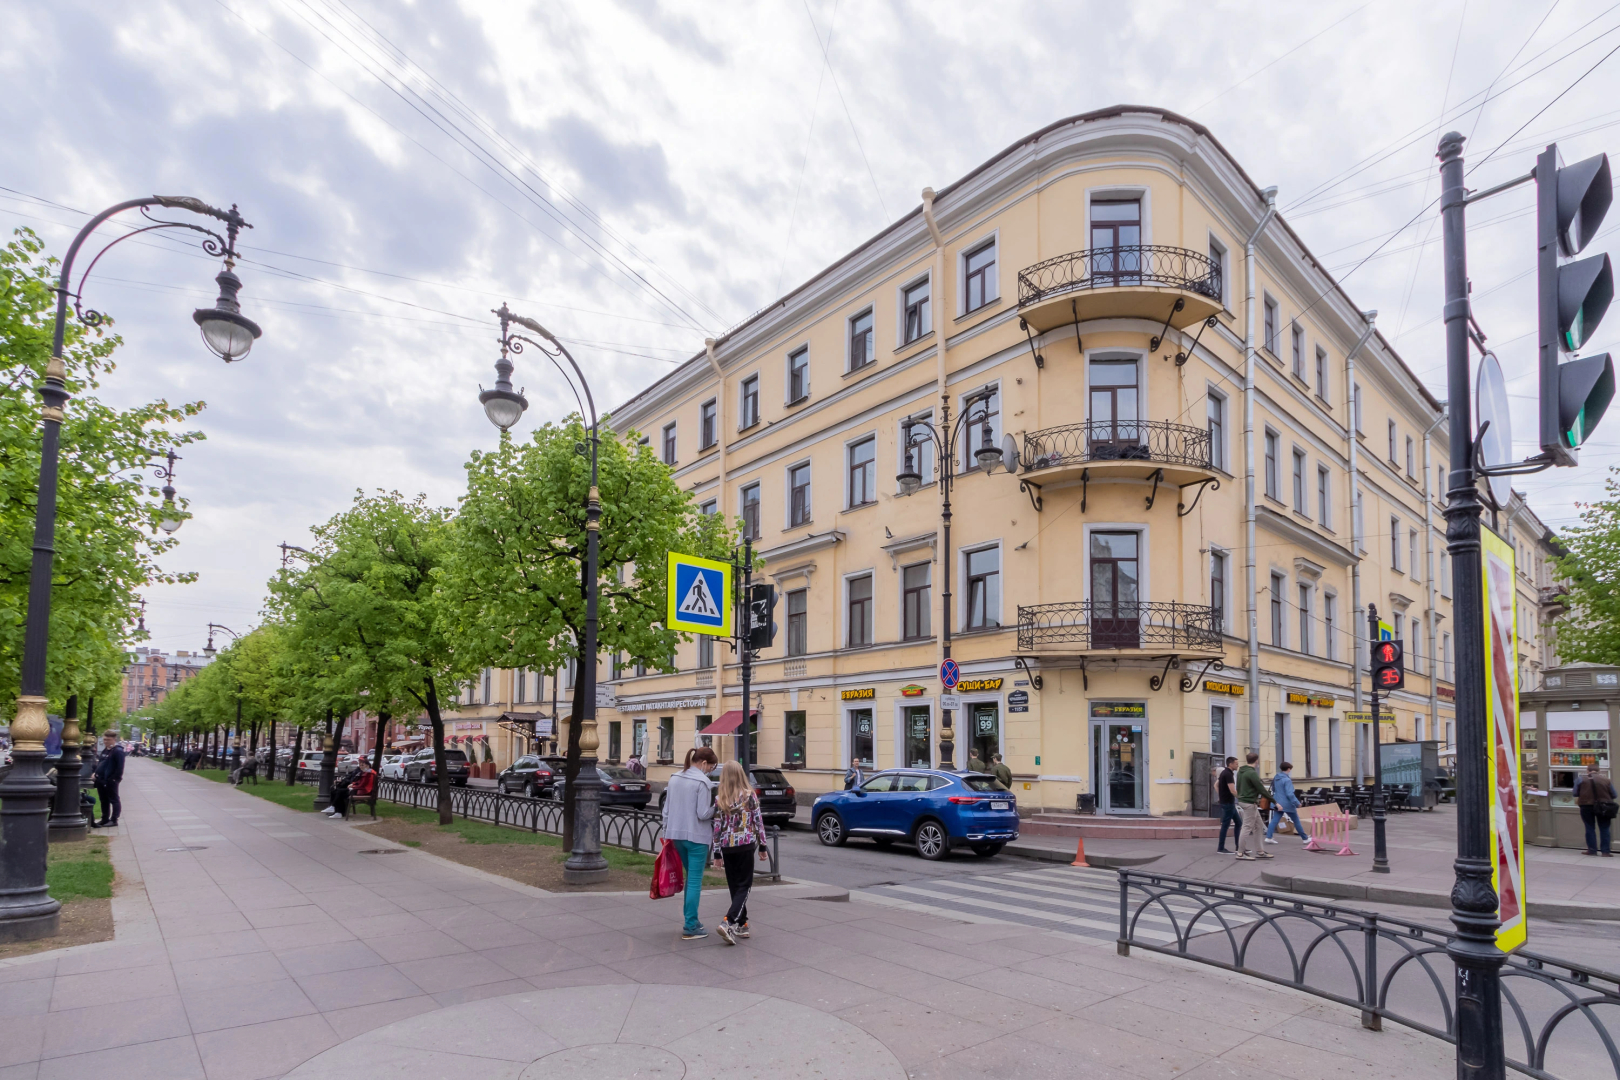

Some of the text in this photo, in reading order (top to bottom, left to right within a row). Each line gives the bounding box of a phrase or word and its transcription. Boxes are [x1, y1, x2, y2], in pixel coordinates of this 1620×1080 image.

[1382, 670, 1399, 684] 35
[957, 679, 1001, 691] СУШИ-БАР
[676, 698, 706, 708] РЕСТОРАН
[860, 724, 869, 732] 69
[980, 721, 992, 729] 99
